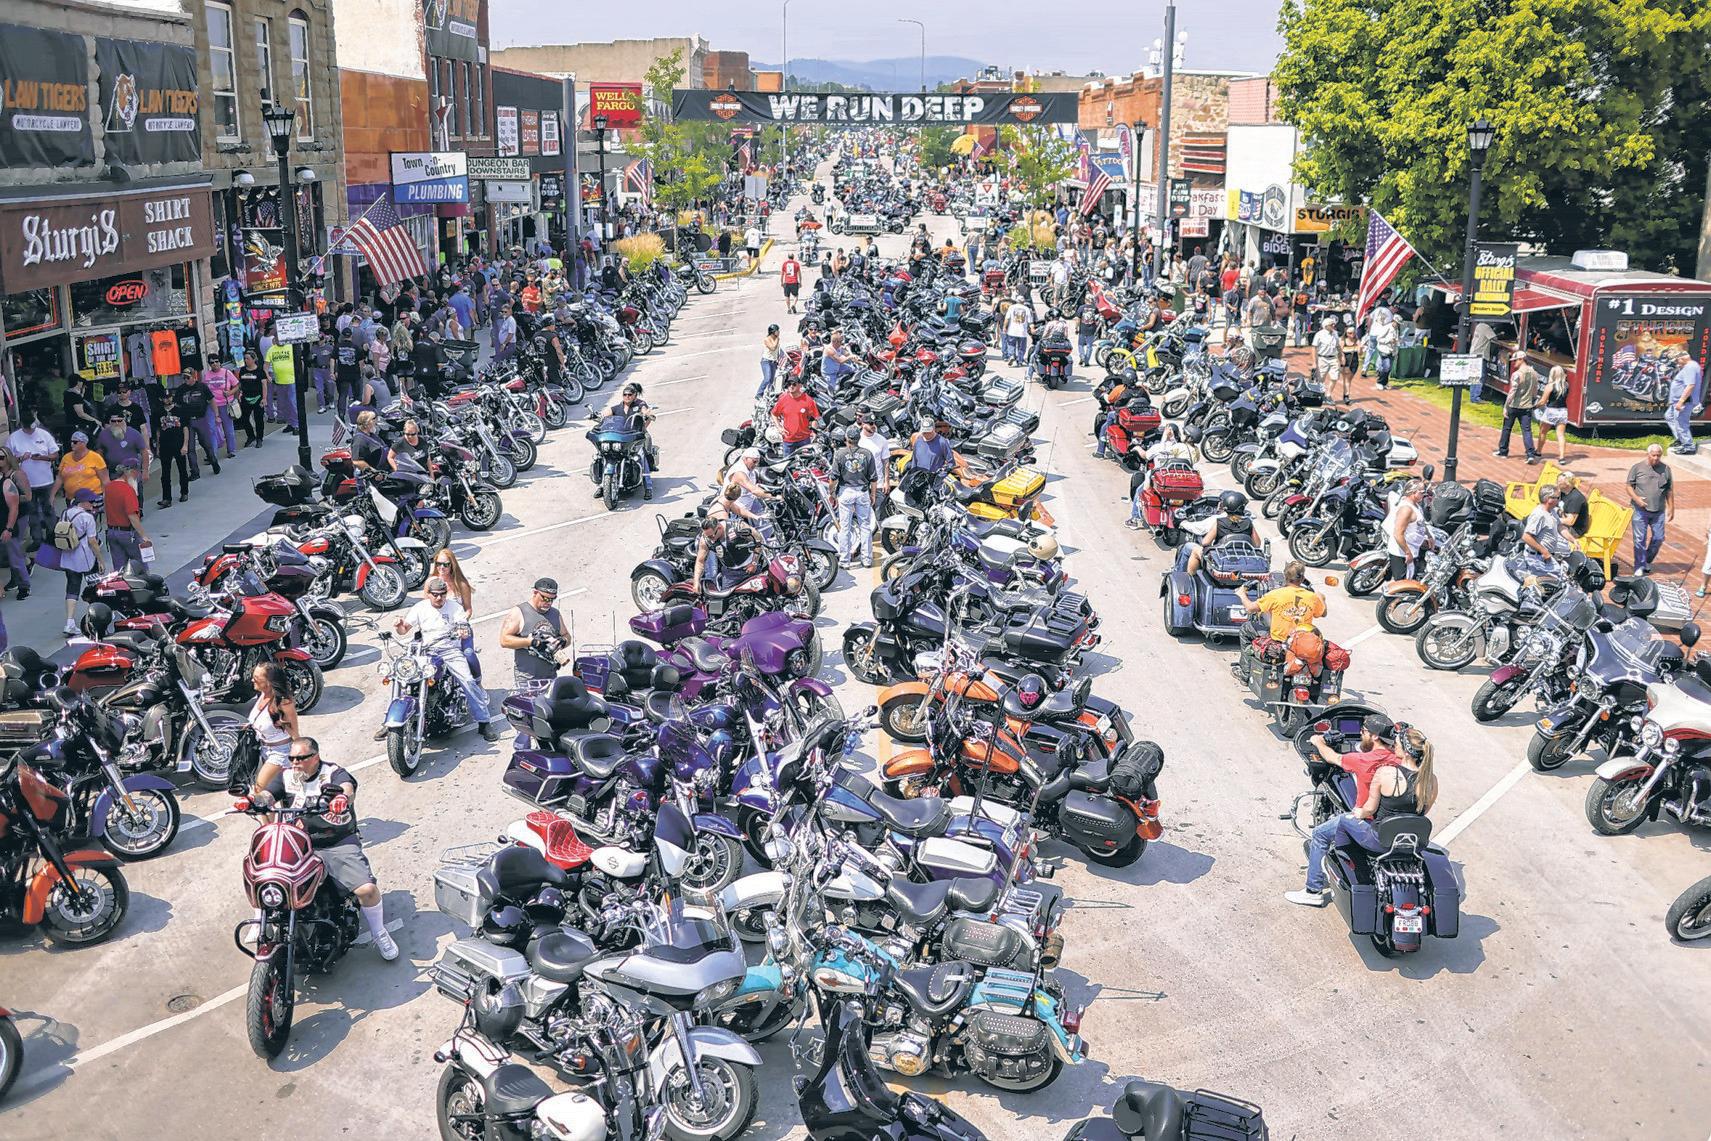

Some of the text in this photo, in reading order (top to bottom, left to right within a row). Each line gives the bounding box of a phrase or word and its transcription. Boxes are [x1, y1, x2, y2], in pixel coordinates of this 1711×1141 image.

[5, 79, 87, 111] LAW TIGERS
[596, 101, 635, 111] FARGO
[768, 95, 985, 121] WE RUN DEEP
[402, 156, 424, 170] Town
[424, 163, 457, 177] Country
[511, 159, 529, 168] BAR
[469, 167, 526, 175] DOWNSTAIRS
[408, 184, 463, 200] PLUMBING
[144, 198, 190, 223] SHIRT
[1199, 205, 1218, 216] Day
[1297, 208, 1360, 220] STURGIS
[147, 226, 194, 253] SHACK
[1270, 233, 1290, 242] JOE
[1477, 252, 1515, 267] Sturgis
[1475, 267, 1514, 280] OFFICIAL
[108, 284, 145, 300] OPEN
[1480, 280, 1507, 292] RALLY
[1608, 299, 1704, 316] #1 DESIGN
[87, 341, 116, 355] SHIRT
[1701, 328, 1710, 355] SOLD
